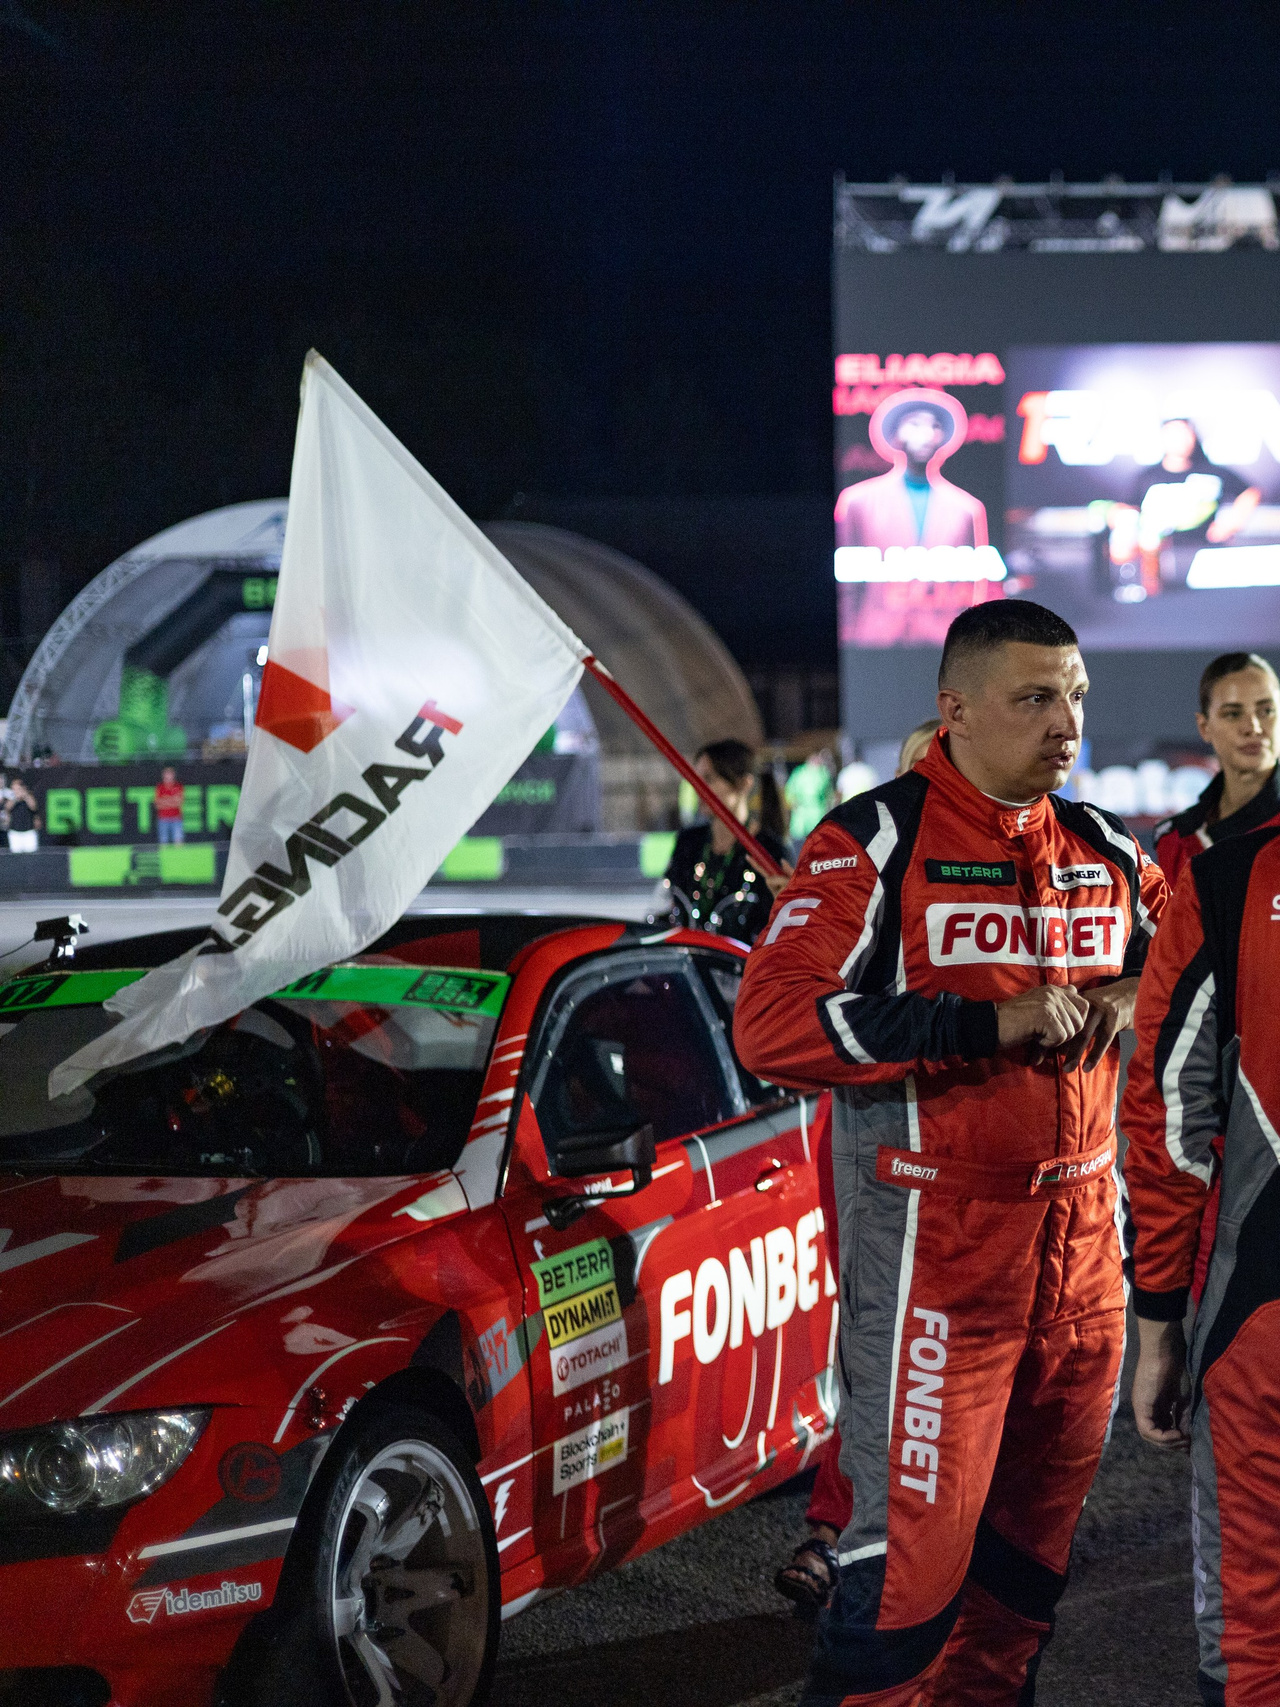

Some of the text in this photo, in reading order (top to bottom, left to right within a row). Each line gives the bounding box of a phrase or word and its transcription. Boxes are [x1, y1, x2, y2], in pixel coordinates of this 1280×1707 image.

[809, 855, 859, 875] freem
[941, 866, 1003, 879] BET.ERA
[940, 912, 1117, 958] FONBET
[892, 1158, 938, 1180] freem
[540, 1247, 611, 1294] BET.ERA
[569, 1339, 621, 1371] TOTACHI
[900, 1307, 949, 1504] FONBET
[165, 1581, 262, 1615] idemitsu
